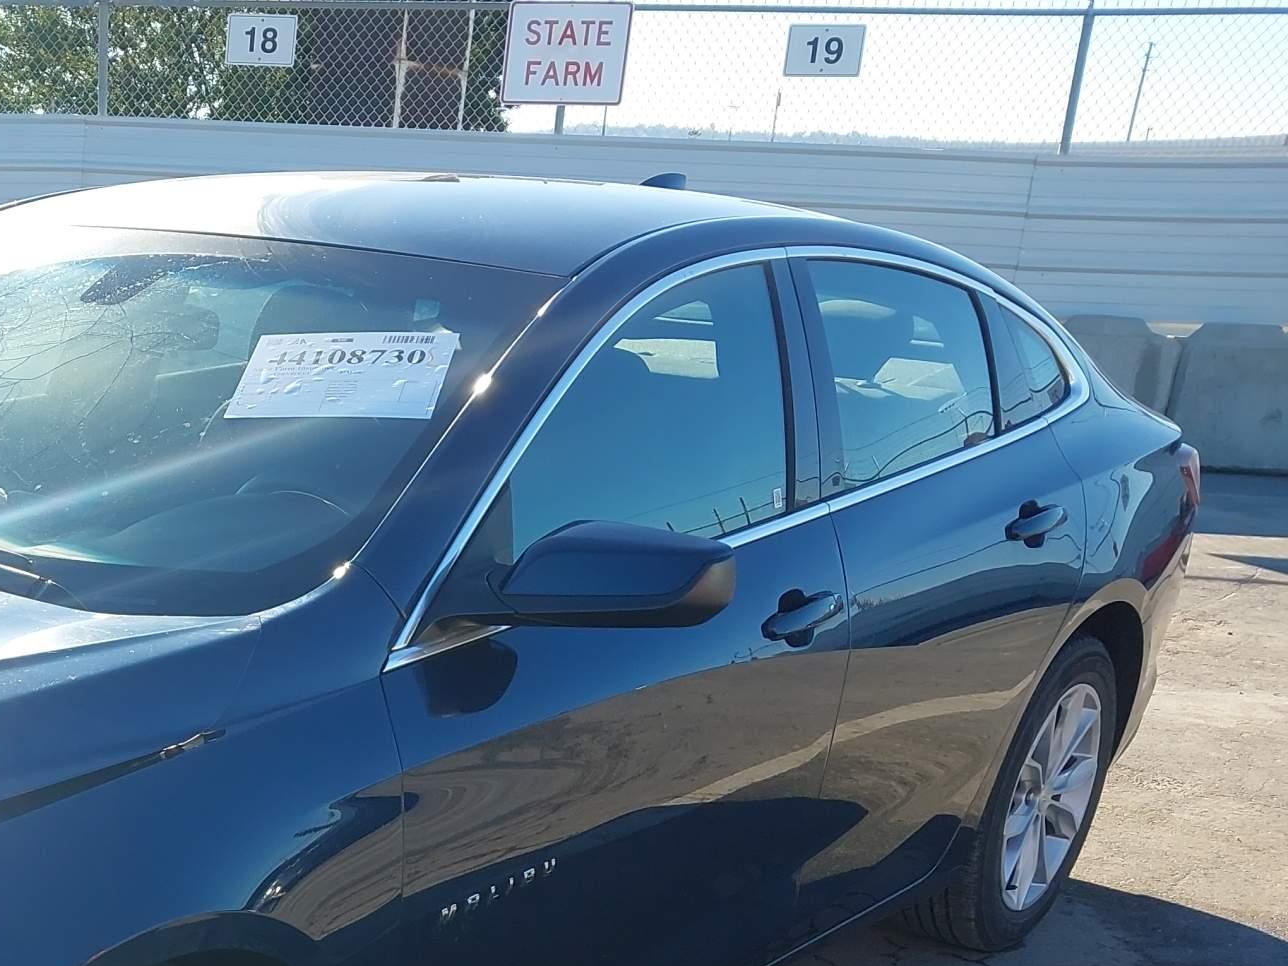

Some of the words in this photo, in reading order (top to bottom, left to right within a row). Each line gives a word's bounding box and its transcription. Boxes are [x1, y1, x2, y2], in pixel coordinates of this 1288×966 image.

[243, 26, 278, 54] 18
[525, 20, 613, 47] STATE
[805, 36, 844, 65] 19
[525, 61, 605, 87] FARM
[268, 348, 427, 366] 44108730
[440, 857, 556, 921] MALIBU
